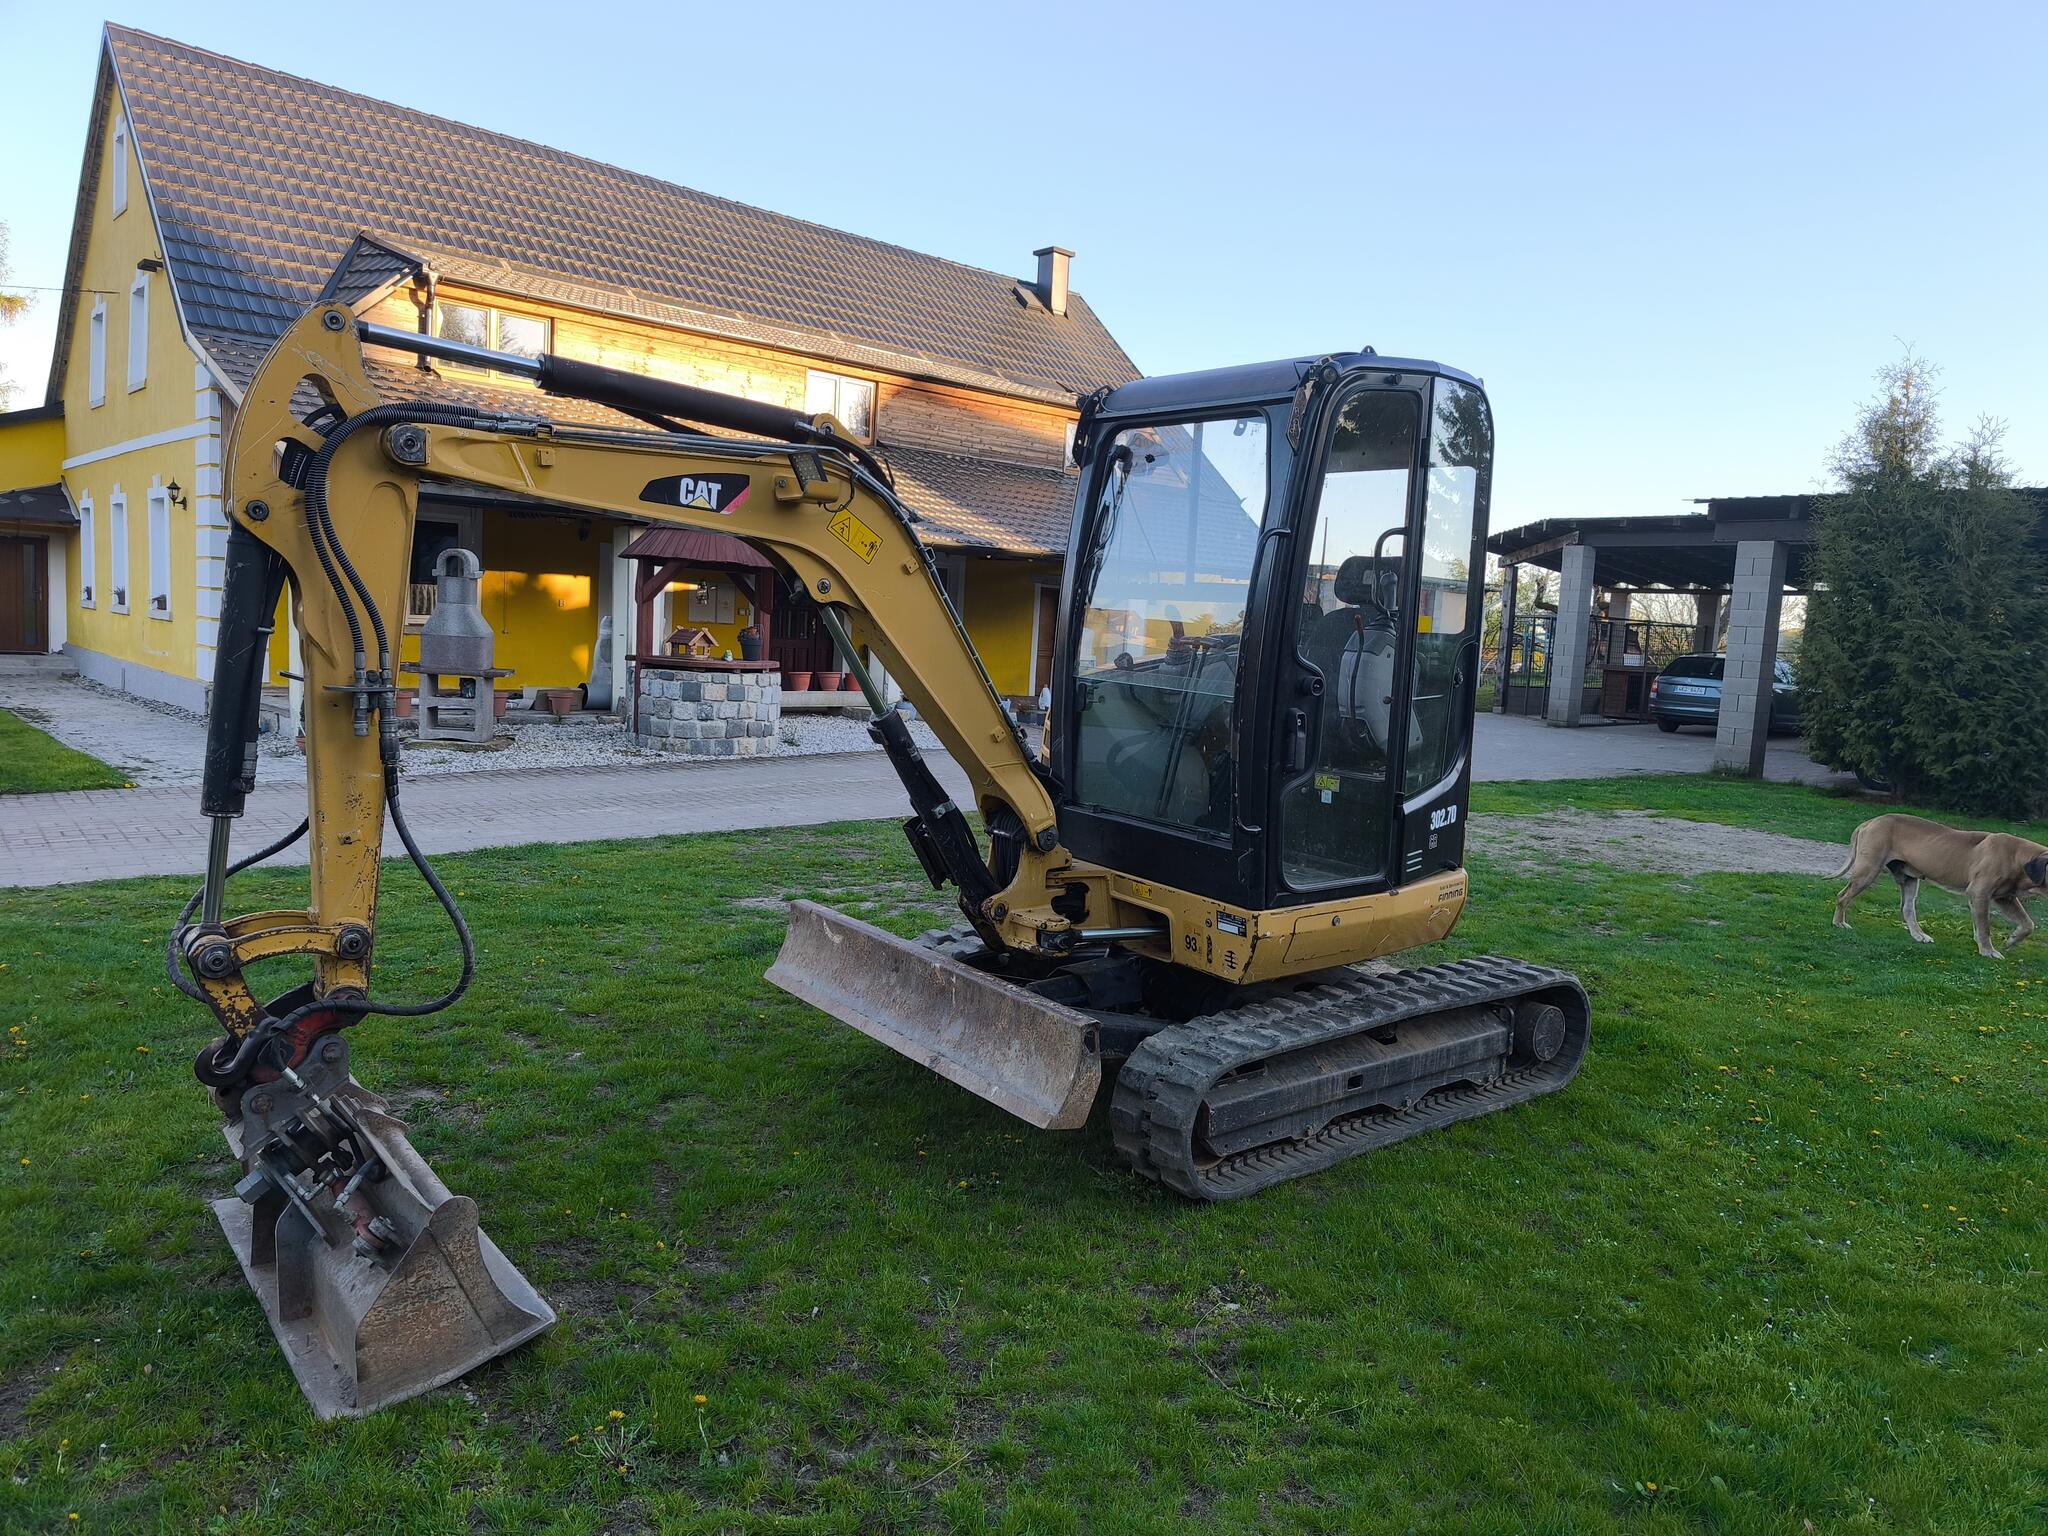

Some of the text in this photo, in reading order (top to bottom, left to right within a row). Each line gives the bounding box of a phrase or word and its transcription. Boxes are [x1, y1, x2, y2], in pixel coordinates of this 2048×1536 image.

[680, 478, 721, 509] CAT
[1430, 804, 1457, 830] 302.7D
[1185, 934, 1197, 952] 93
